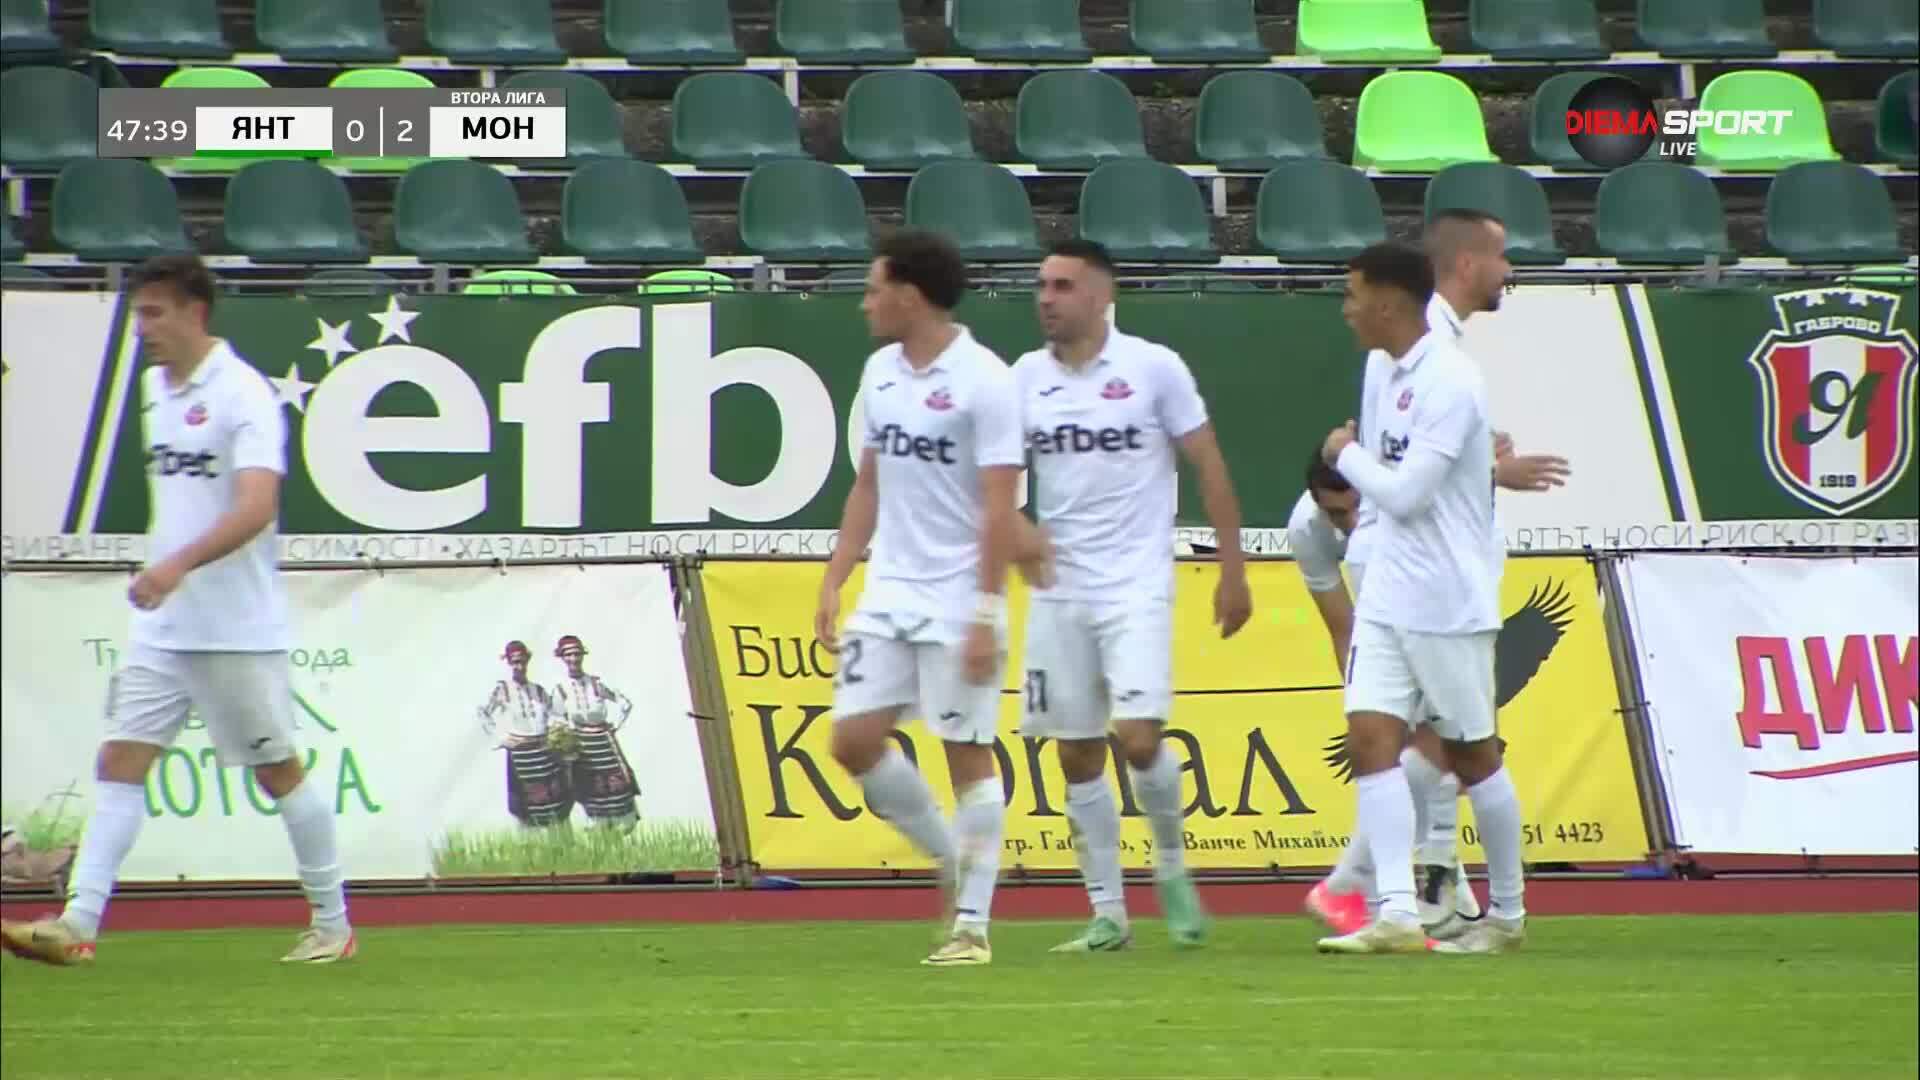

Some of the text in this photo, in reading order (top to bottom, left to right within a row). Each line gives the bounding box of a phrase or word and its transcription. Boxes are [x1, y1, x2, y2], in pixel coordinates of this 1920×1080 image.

[628, 533, 717, 558] НОСИ
[731, 532, 812, 557] РИСК
[1602, 523, 1694, 546] НОСИ
[1707, 522, 1787, 546] РИСК
[1801, 521, 1847, 545] ОТ
[1555, 822, 1604, 843] 4423
[1004, 839, 1033, 856] гр.
